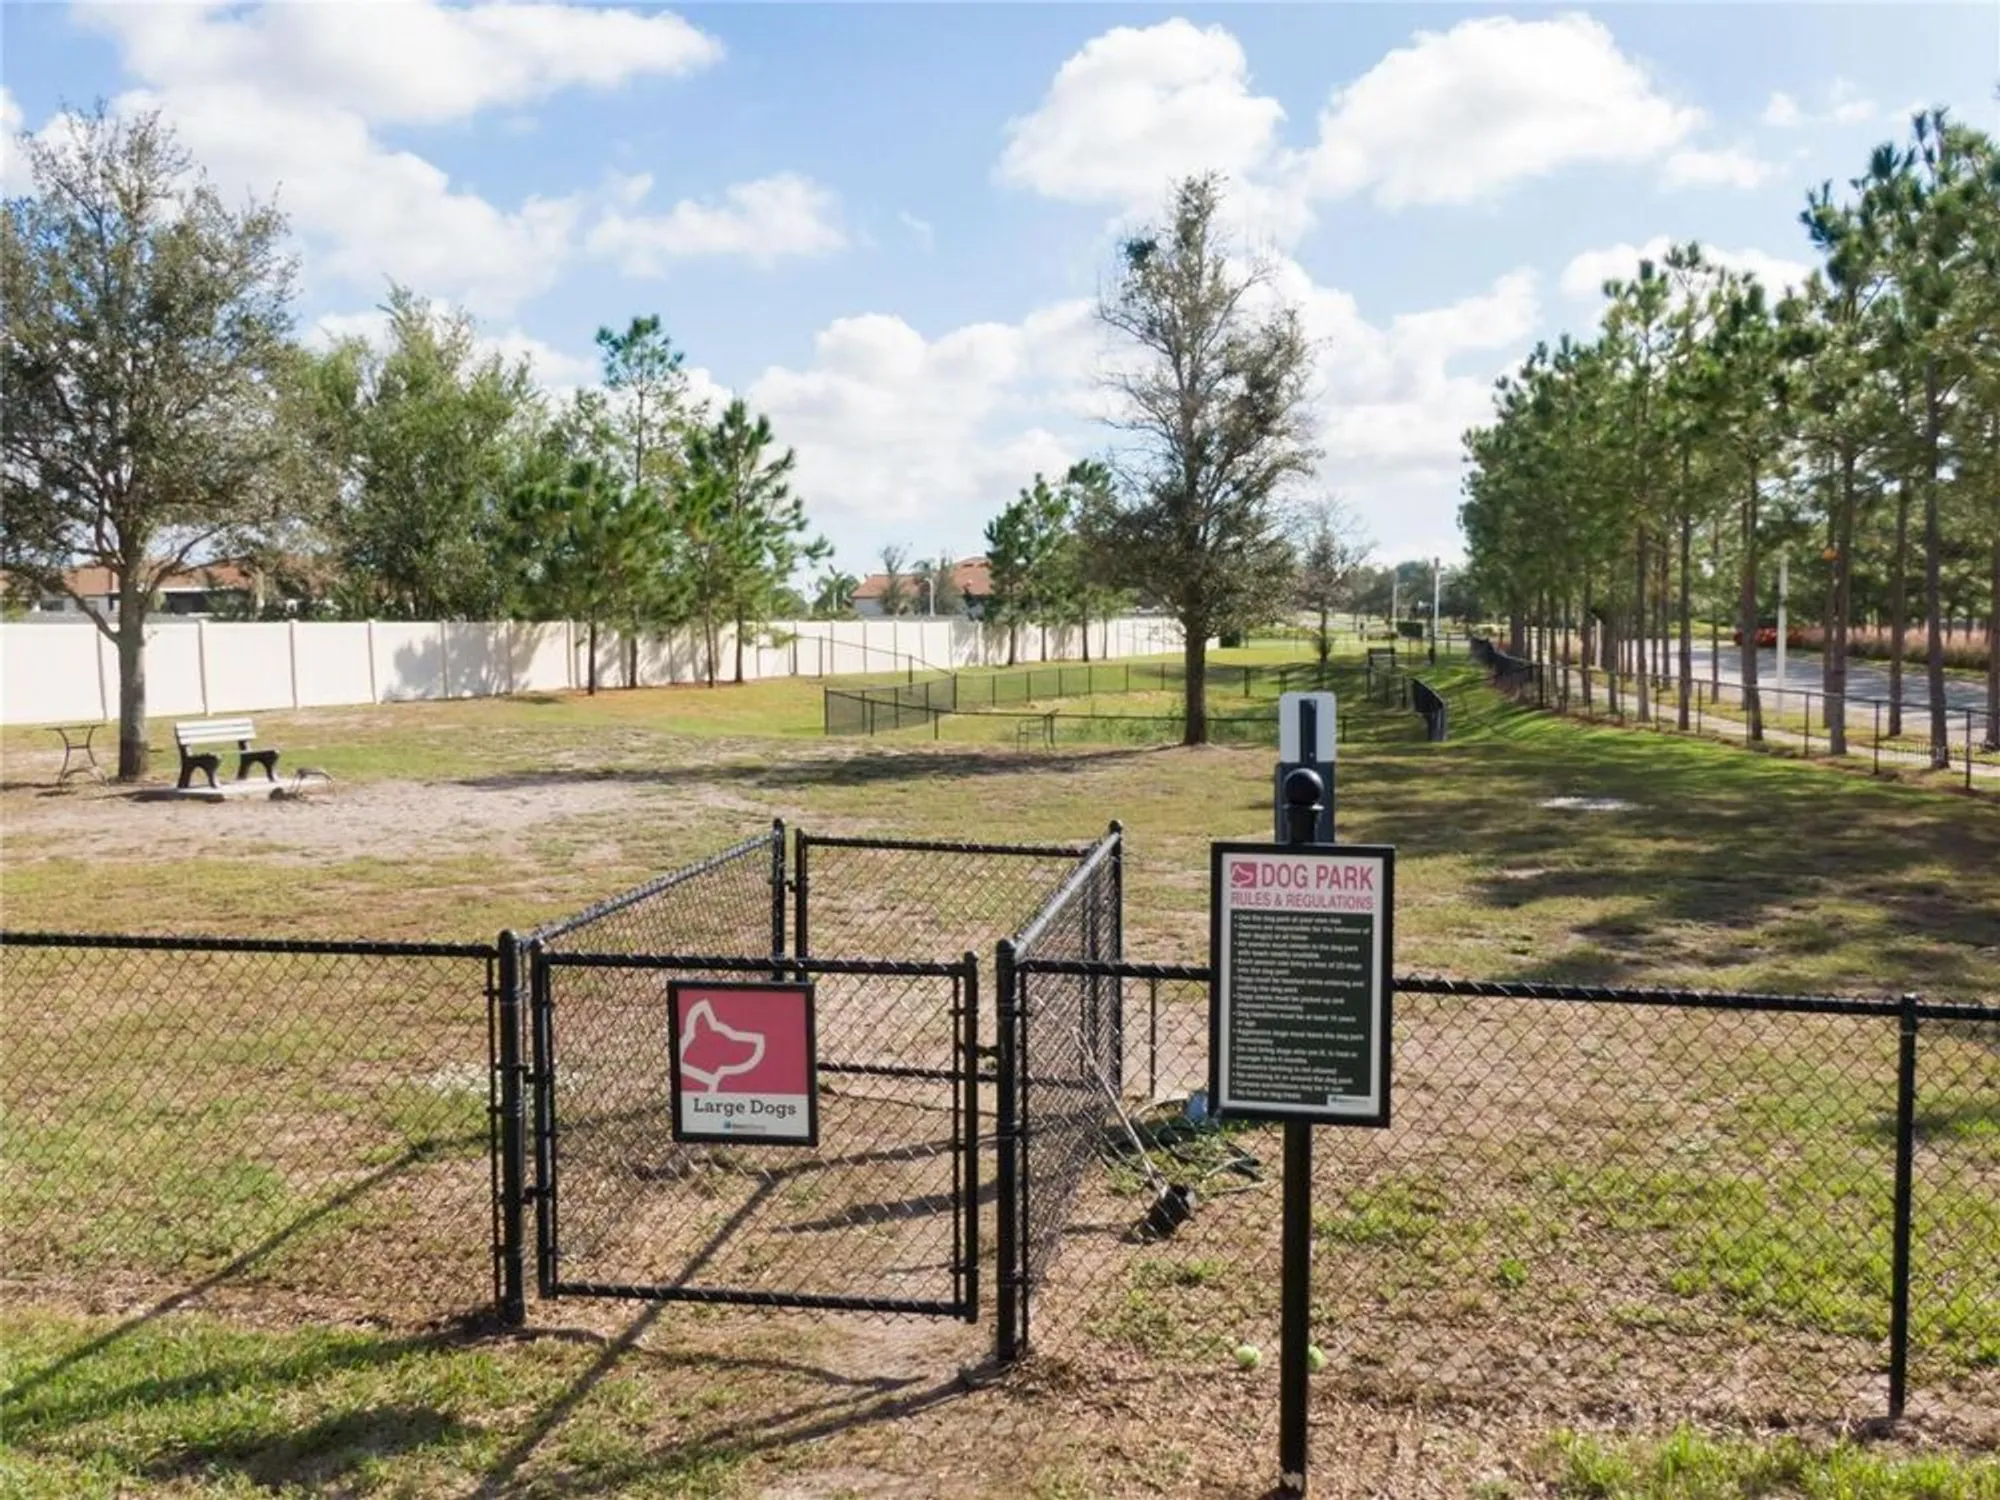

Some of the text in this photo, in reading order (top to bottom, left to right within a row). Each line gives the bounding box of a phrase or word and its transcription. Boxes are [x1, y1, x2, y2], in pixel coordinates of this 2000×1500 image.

[1262, 863, 1374, 890] DOG PARK
[1231, 892, 1374, 910] RULES & REGULATIONS
[694, 1098, 796, 1118] Large Dogs
